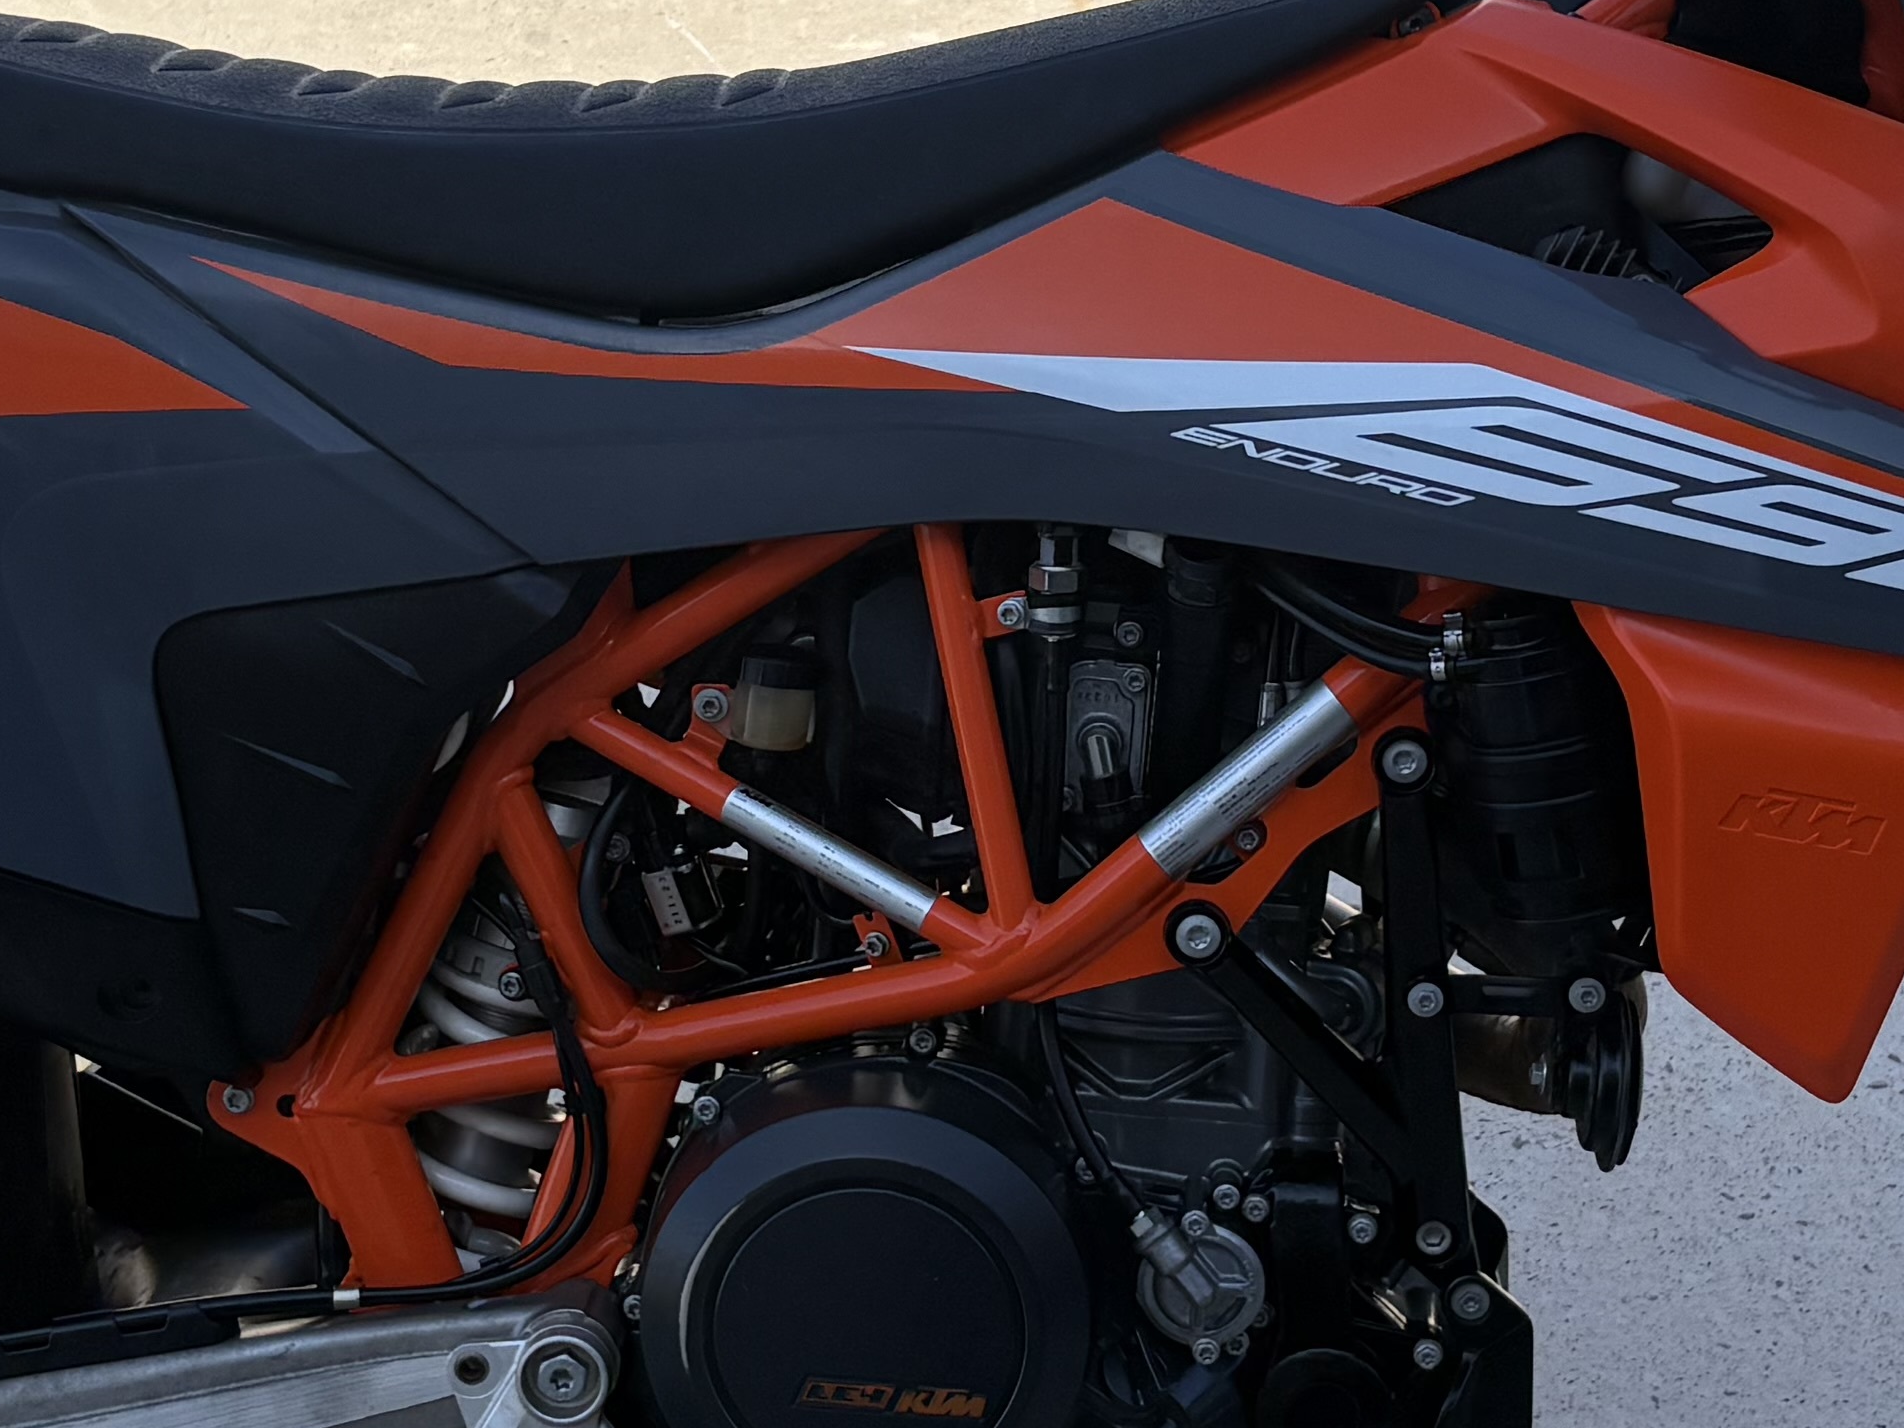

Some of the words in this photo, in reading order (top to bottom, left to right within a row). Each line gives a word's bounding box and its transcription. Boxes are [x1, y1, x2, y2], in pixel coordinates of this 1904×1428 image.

[1170, 426, 1476, 506] ENDURO
[1718, 787, 1889, 855] KTM
[893, 1385, 987, 1420] KTM
